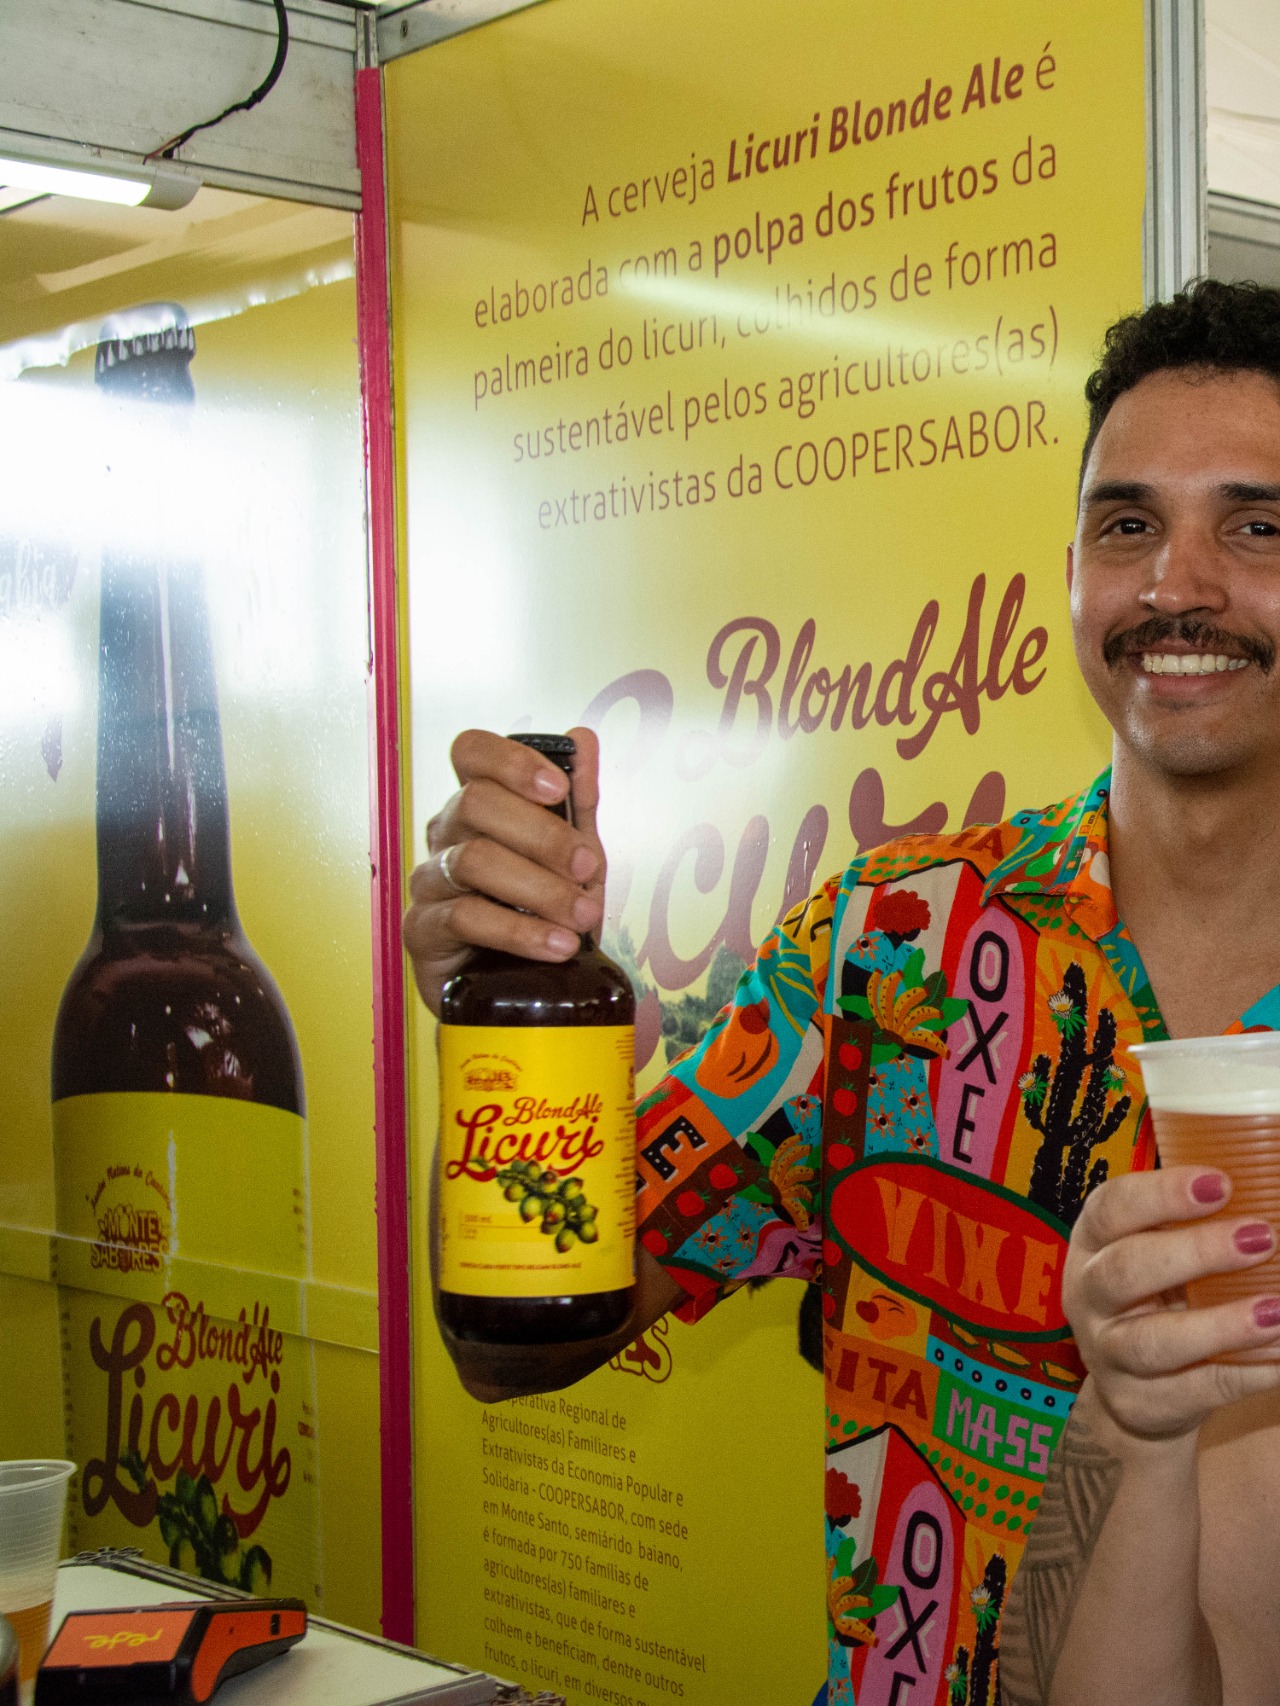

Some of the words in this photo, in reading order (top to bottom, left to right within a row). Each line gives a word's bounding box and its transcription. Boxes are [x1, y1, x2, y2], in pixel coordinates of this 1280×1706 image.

[581, 184, 600, 226] A
[608, 152, 715, 219] cerveja
[727, 113, 821, 183] Licuri
[828, 77, 953, 153] Blonde
[962, 57, 1025, 114] Ale
[1035, 41, 1057, 89] é
[474, 259, 609, 328] elaborada
[619, 246, 677, 290] com
[688, 239, 702, 271] a
[713, 210, 804, 275] polpa
[815, 191, 876, 238] dos
[885, 158, 998, 220] frutos
[1012, 136, 1057, 185] da
[474, 337, 588, 411] palmeira
[599, 329, 633, 371] do
[643, 311, 727, 361] licuri,
[735, 272, 877, 339] colhidos
[890, 255, 932, 302] de
[944, 232, 1057, 291] forma
[513, 391, 674, 462] sustentável
[684, 377, 767, 440] pelos
[779, 305, 1059, 419] agricultores(as)
[538, 466, 717, 529] extrativistas
[727, 454, 763, 496] da
[773, 400, 1059, 489] COOPERSABOR.
[952, 930, 1011, 1164] OXE
[446, 1105, 604, 1181] Licuri
[874, 1177, 1058, 1326] VIXE
[83, 1303, 291, 1538] Licuri
[482, 1410, 565, 1448] Agricultores(as)
[568, 1430, 626, 1461] Familiares
[629, 1449, 636, 1464] e
[559, 1397, 609, 1427] Regional
[612, 1411, 626, 1431] de
[482, 1437, 549, 1471] Extrativistas
[551, 1457, 565, 1476] da
[568, 1460, 623, 1491] Economia
[626, 1475, 673, 1504] Popular
[676, 1491, 684, 1508] e
[483, 1501, 499, 1516] em
[501, 1501, 535, 1527] Monte
[538, 1512, 572, 1540] Santo,
[575, 1526, 633, 1555] semiárido
[638, 1540, 683, 1573] baiano,
[538, 1482, 628, 1525] COOPERSABOR,
[630, 1511, 656, 1530] com
[659, 1518, 689, 1540] sede
[483, 1525, 490, 1543] é
[492, 1527, 537, 1557] formada
[539, 1545, 557, 1564] por
[560, 1550, 582, 1571] 750
[634, 1571, 649, 1592] de
[484, 1557, 566, 1599] agricultores(as)
[569, 1581, 625, 1613] familiares
[629, 1604, 635, 1618] e
[484, 1615, 523, 1641] colhem
[526, 1630, 532, 1644] e
[603, 1655, 641, 1682] dentre
[645, 1671, 684, 1697] outros
[521, 1658, 528, 1672] o
[564, 1675, 581, 1692] em
[556, 1610, 577, 1630] que
[580, 1616, 594, 1635] de
[597, 1621, 632, 1648] forma
[635, 1636, 706, 1673] sustentável
